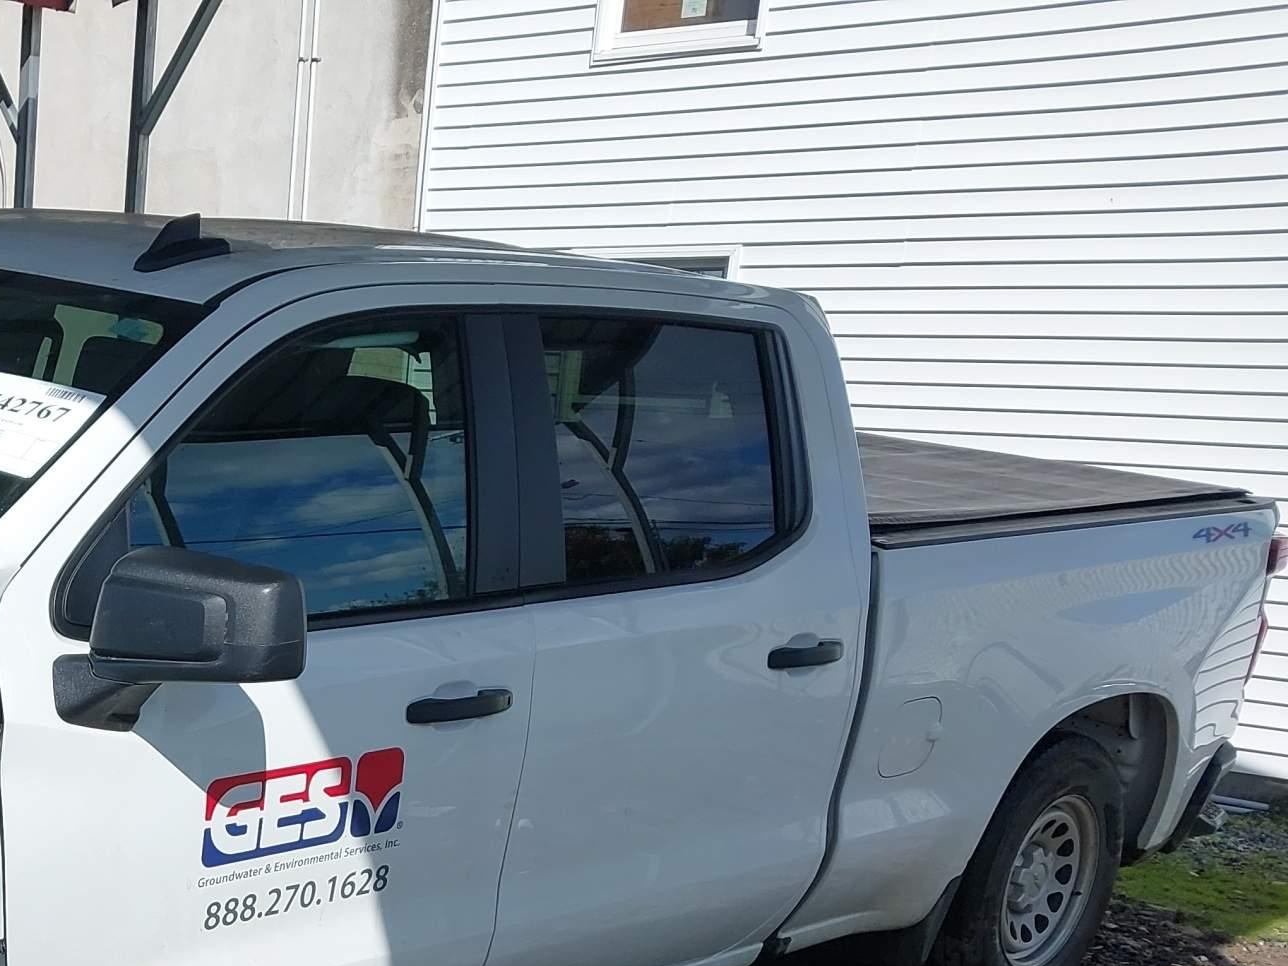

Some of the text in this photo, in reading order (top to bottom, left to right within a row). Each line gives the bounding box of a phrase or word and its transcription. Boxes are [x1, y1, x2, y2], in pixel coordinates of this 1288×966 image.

[211, 766, 344, 856] GES
[197, 837, 401, 888] Groundwater & Environmental Services, Inc.
[204, 864, 390, 931] 888.270.1628
